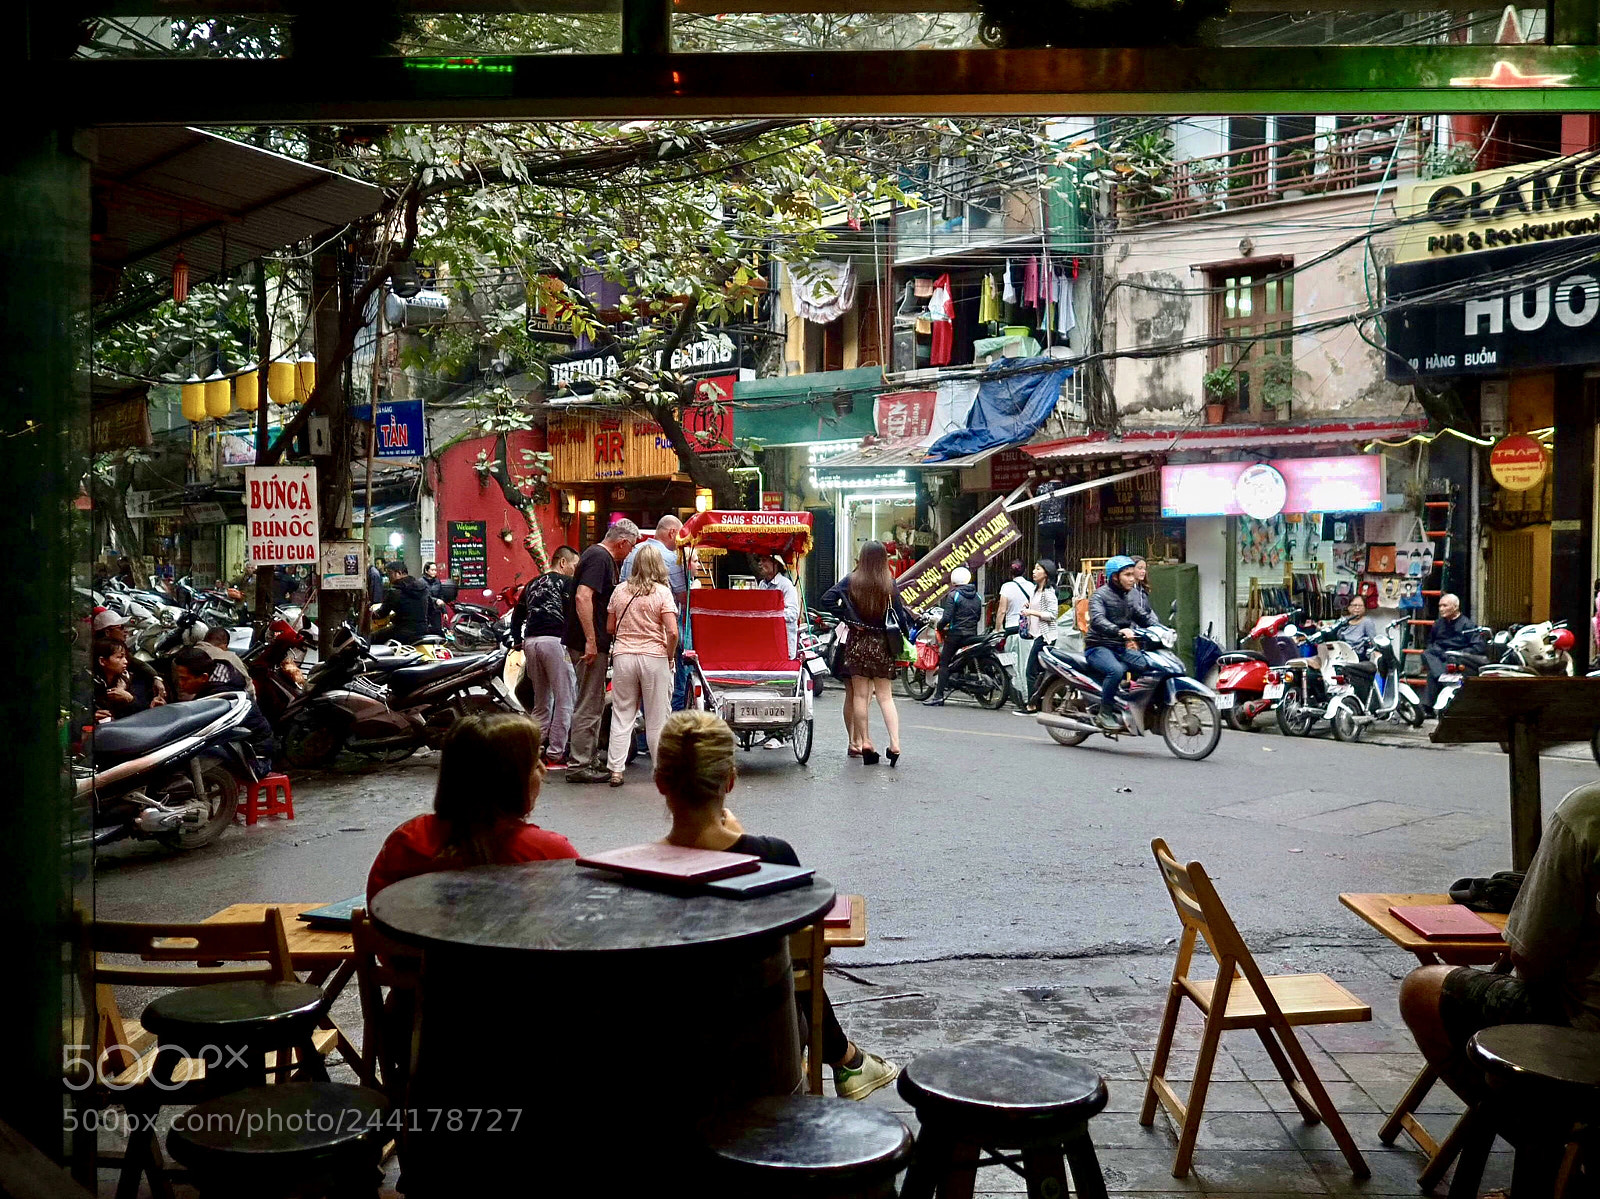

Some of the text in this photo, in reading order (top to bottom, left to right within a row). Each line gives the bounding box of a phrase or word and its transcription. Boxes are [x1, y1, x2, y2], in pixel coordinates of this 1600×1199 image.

[1425, 353, 1456, 369] HÀNG
[1494, 447, 1540, 457] TRAP
[721, 515, 745, 525] SANS
[751, 515, 777, 525] SOUCI
[286, 544, 315, 560] CUA
[900, 586, 920, 605] BIA
[974, 527, 993, 545] GIA
[987, 512, 1010, 536] LINH
